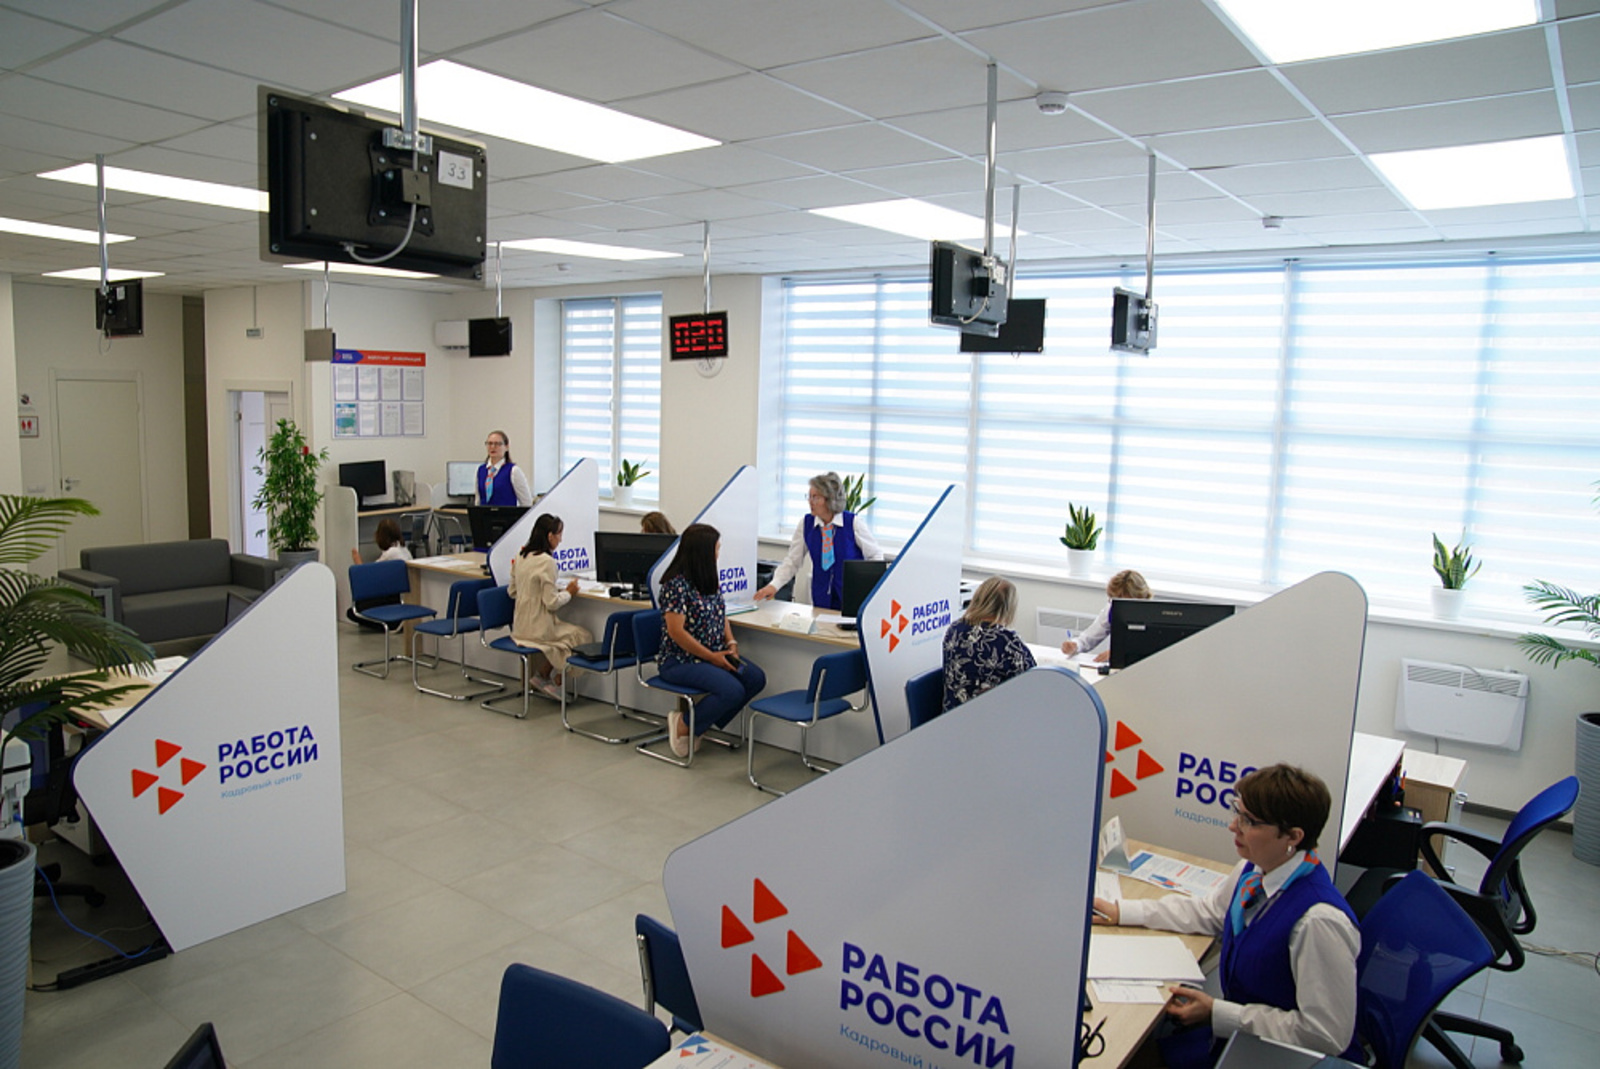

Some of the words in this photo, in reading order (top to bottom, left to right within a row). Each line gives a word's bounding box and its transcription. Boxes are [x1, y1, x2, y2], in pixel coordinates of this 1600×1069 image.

[448, 163, 466, 180] 33
[674, 319, 724, 353] 020
[552, 547, 588, 560] АБОТА
[719, 566, 746, 581] БОТА
[719, 579, 748, 594] ССИИ
[913, 599, 950, 620] РАБОТА
[911, 612, 951, 636] РОССИИ
[218, 725, 314, 762] РАБОТА
[219, 743, 318, 784] РОССИИ
[1178, 752, 1258, 783] РАБ
[221, 780, 272, 798] Кадровый
[274, 772, 303, 785] центр
[1175, 777, 1238, 810] РОС
[1174, 807, 1228, 828] Кадровы
[843, 941, 1010, 1035] РАБОТА
[840, 979, 1016, 1069] РОССИИ
[840, 1024, 923, 1069] Кадровый
